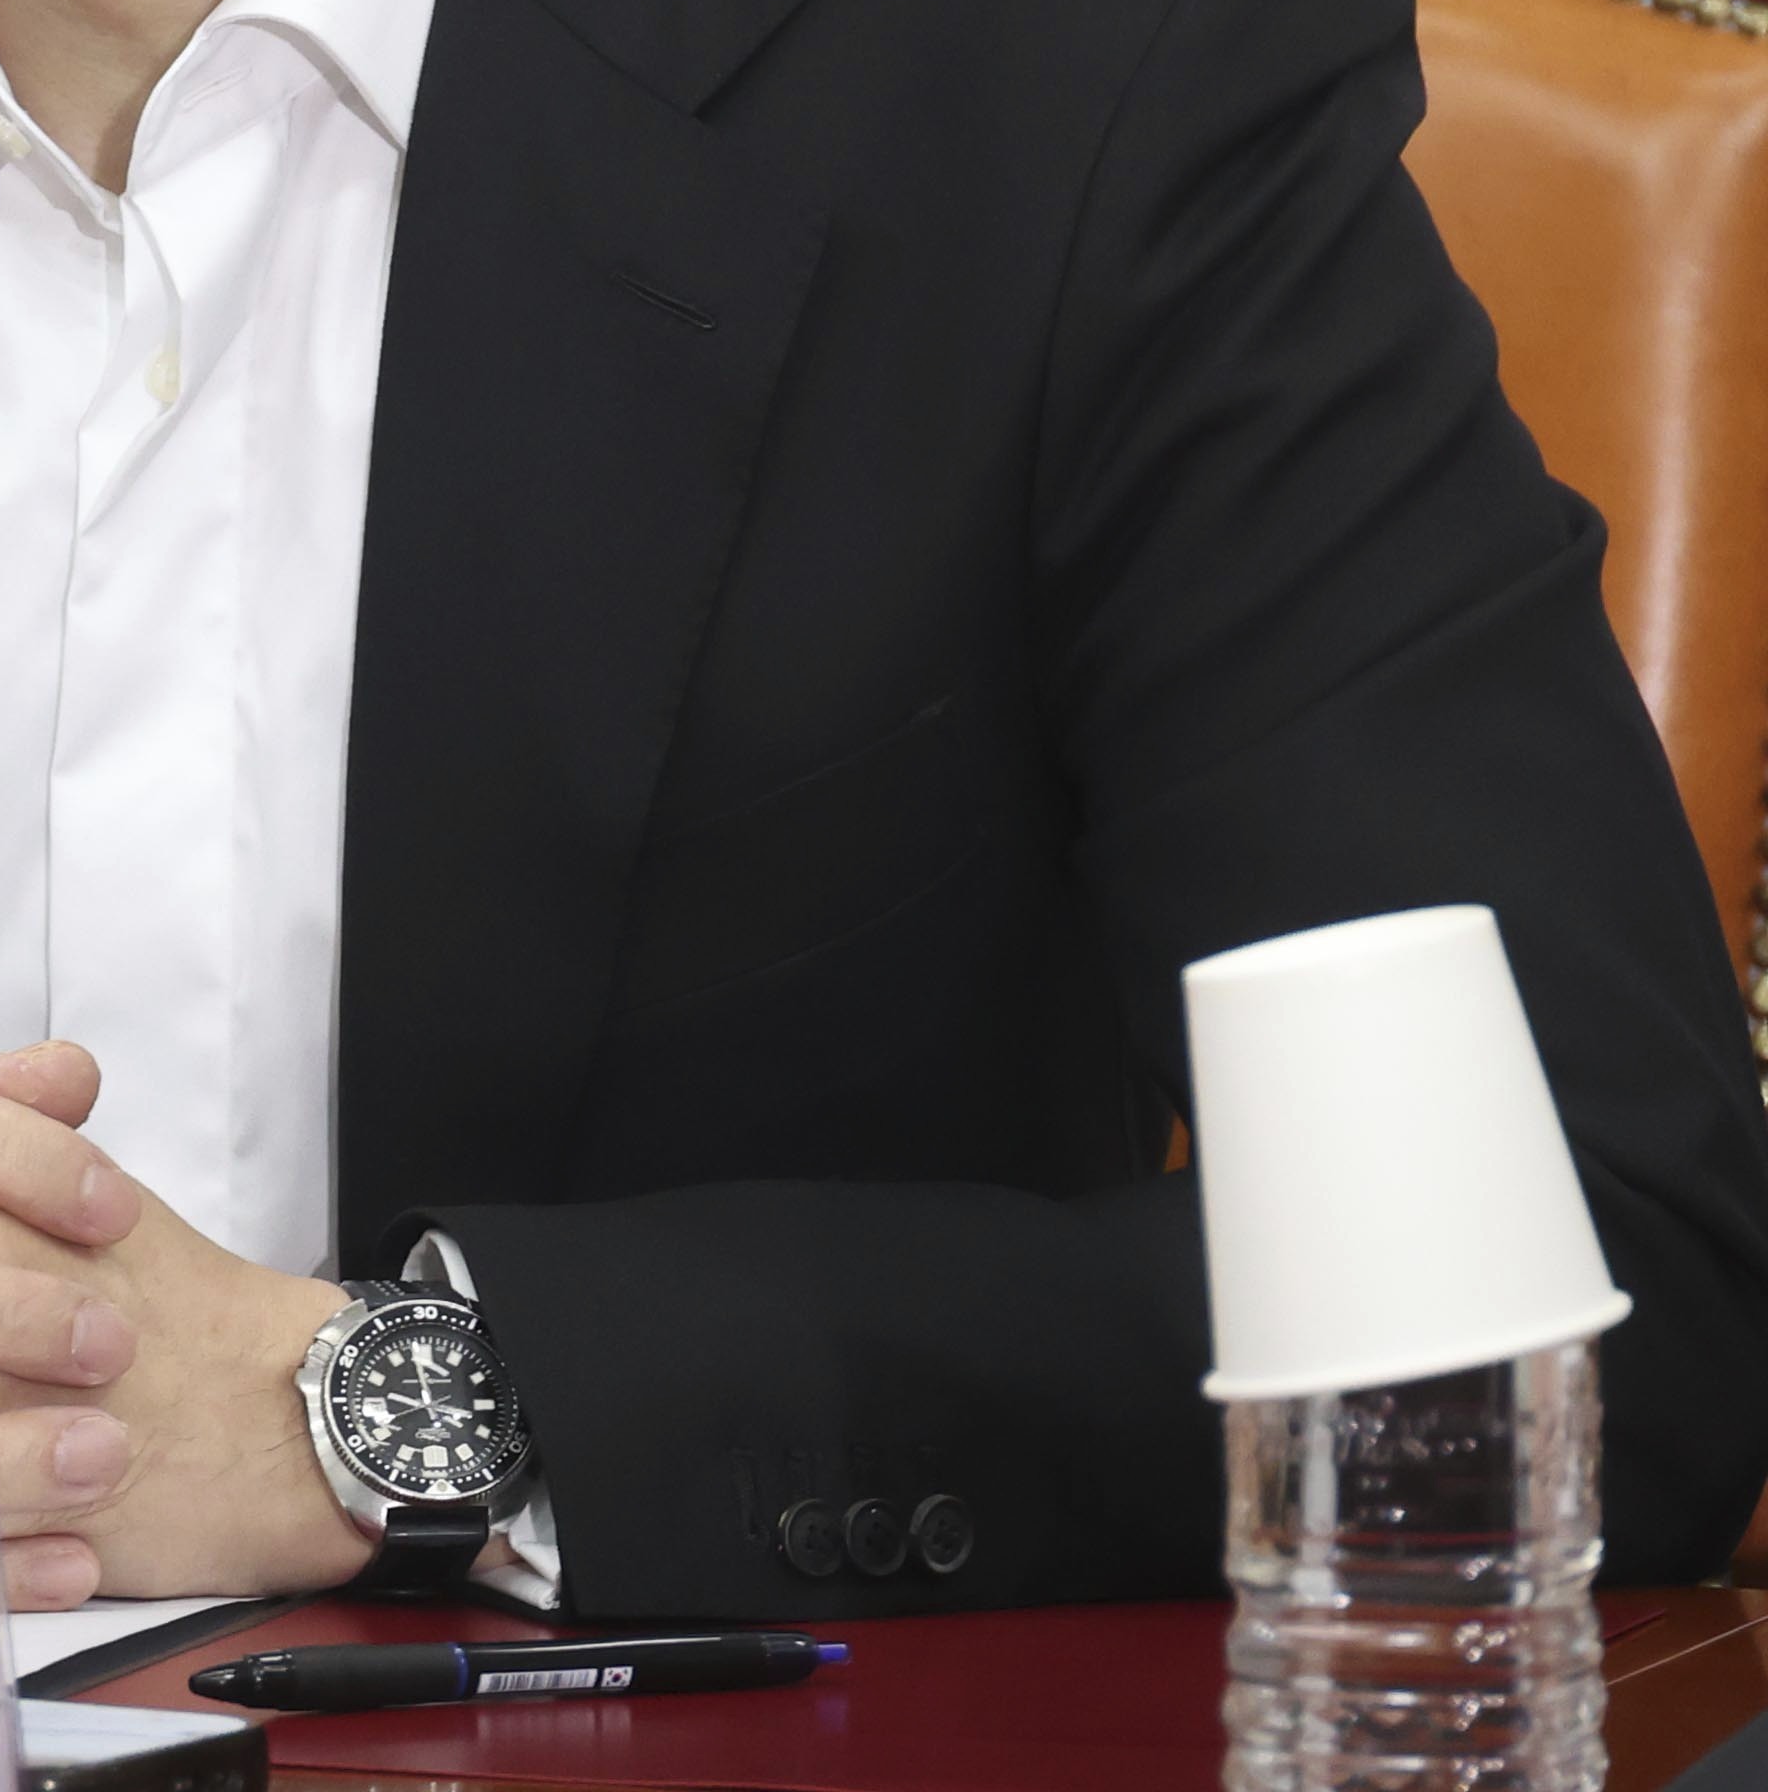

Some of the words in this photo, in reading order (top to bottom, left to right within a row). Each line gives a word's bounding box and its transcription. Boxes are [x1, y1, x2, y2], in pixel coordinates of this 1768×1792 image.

[412, 1306, 438, 1320] 30
[339, 1344, 360, 1369] 20
[346, 1434, 367, 1454] 10
